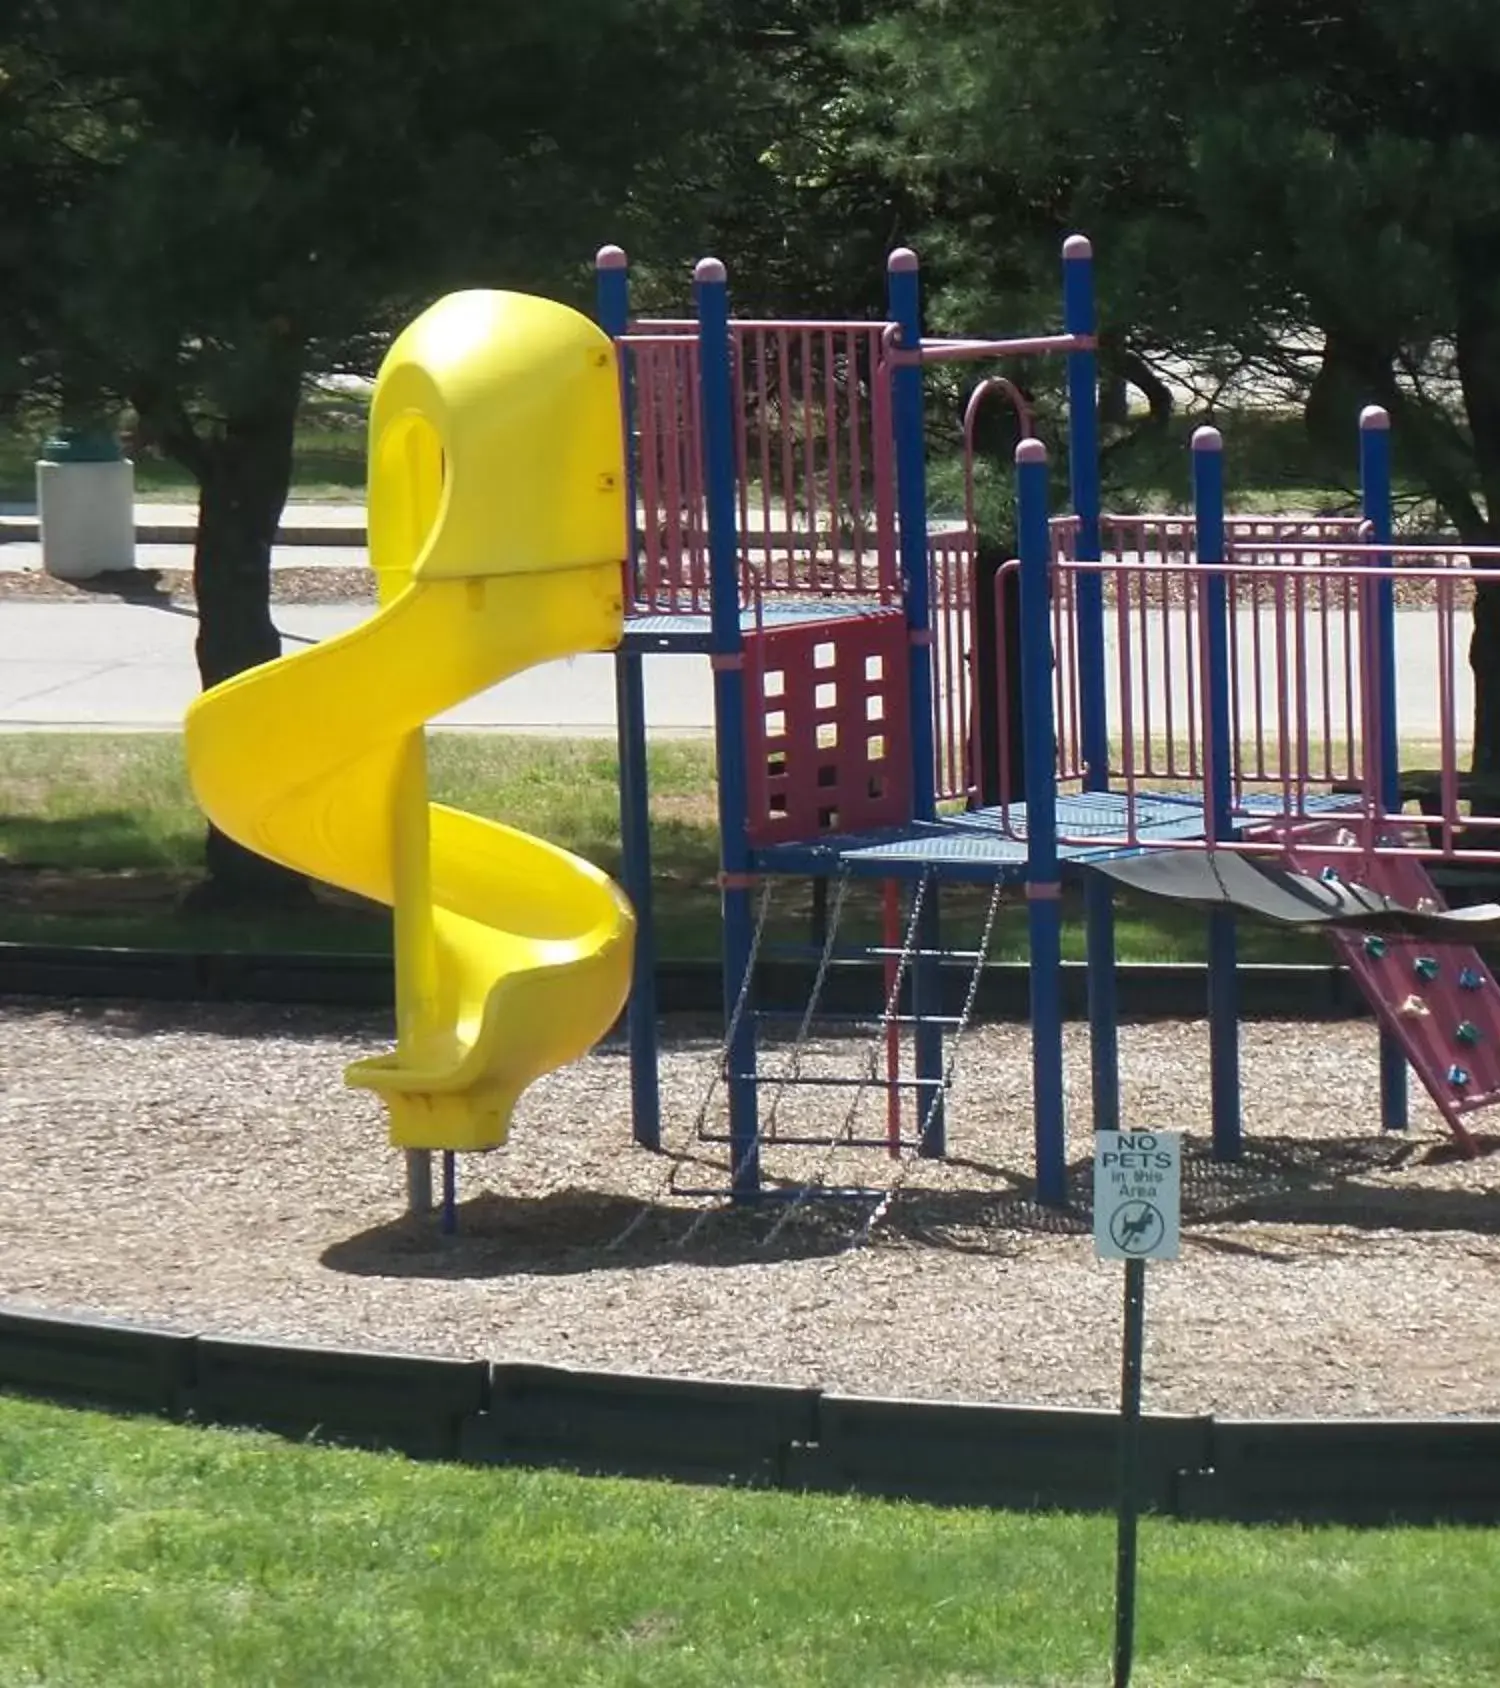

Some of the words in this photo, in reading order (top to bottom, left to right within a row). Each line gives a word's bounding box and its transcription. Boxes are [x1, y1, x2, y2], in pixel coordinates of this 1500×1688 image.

[1117, 1135, 1158, 1151] NO
[1102, 1151, 1172, 1169] PETS
[1111, 1171, 1125, 1183] in
[1133, 1169, 1163, 1183] this
[1119, 1184, 1157, 1197] Area
